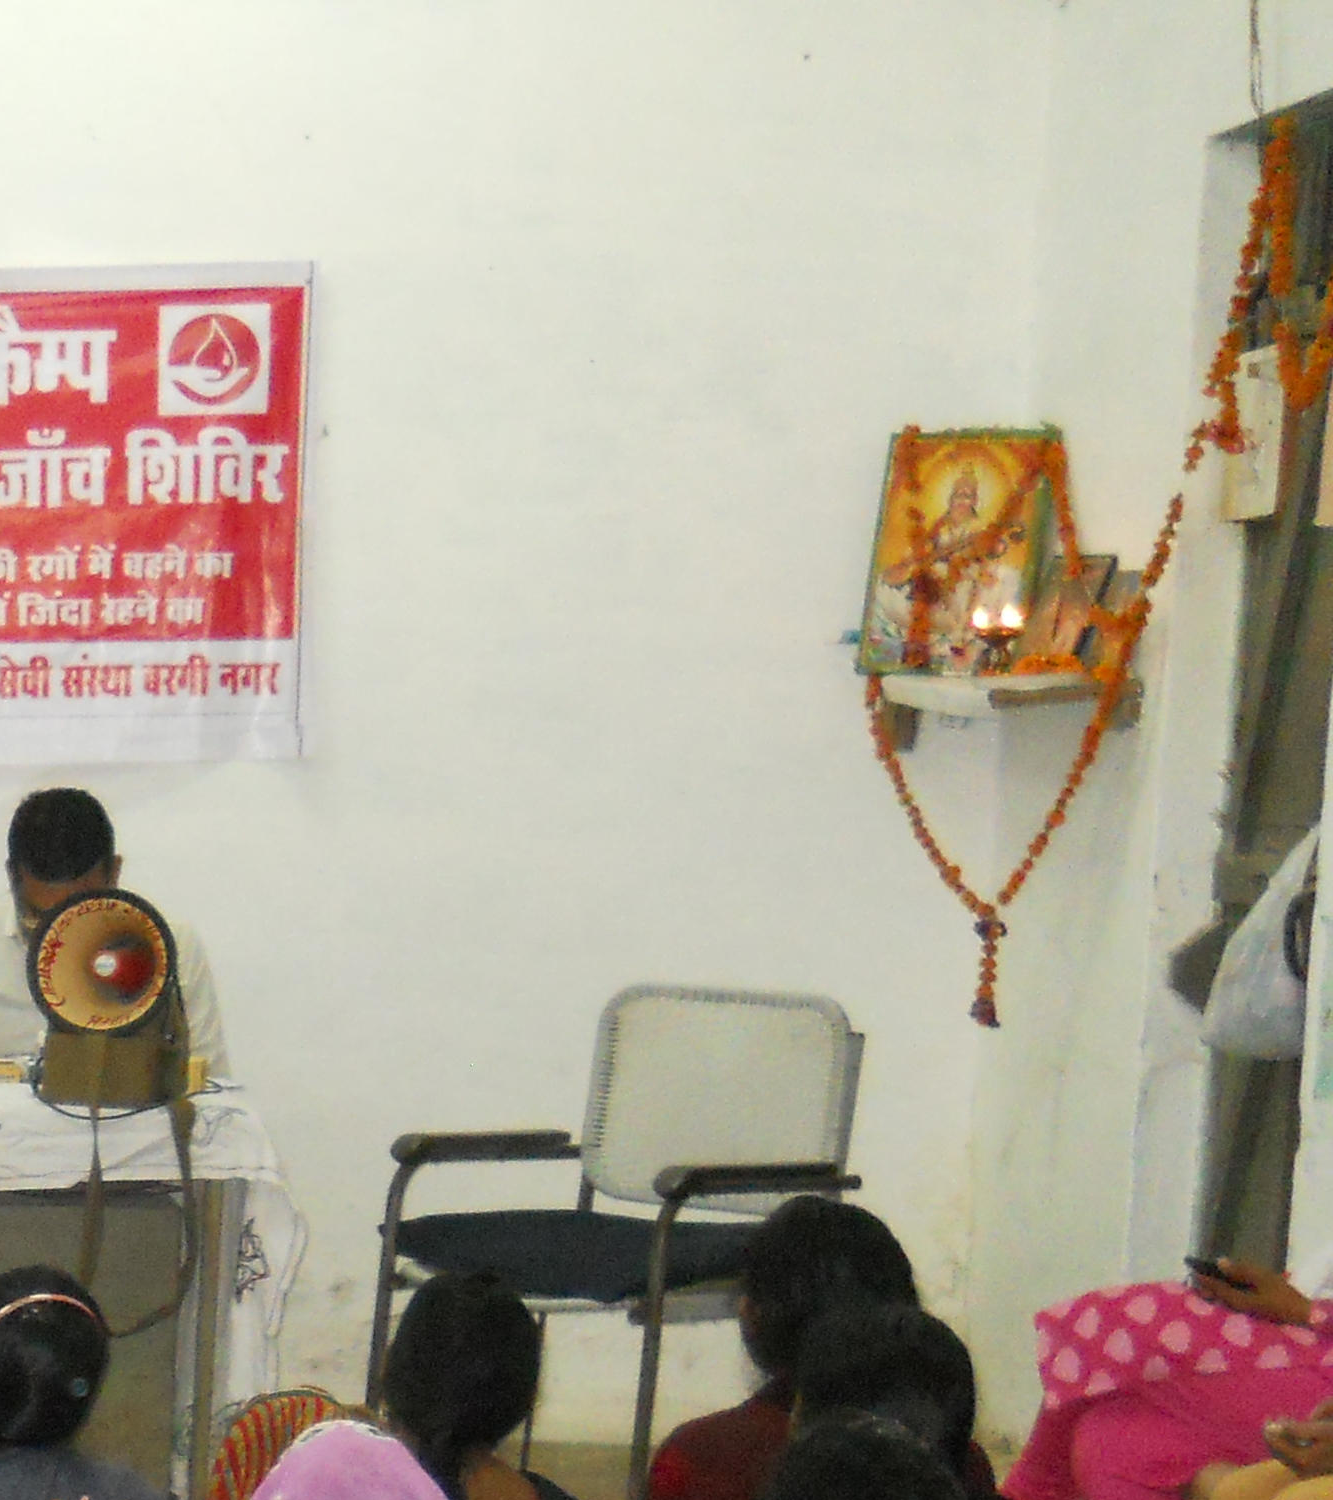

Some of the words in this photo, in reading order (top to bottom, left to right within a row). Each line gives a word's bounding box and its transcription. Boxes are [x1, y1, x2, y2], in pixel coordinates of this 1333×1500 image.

[124, 427, 289, 505] शिविर
[87, 542, 117, 580] में
[193, 549, 234, 580] का
[16, 589, 91, 628] जिंदा
[165, 598, 207, 625] का
[142, 654, 212, 697] बरगी
[217, 661, 282, 696] नगर
